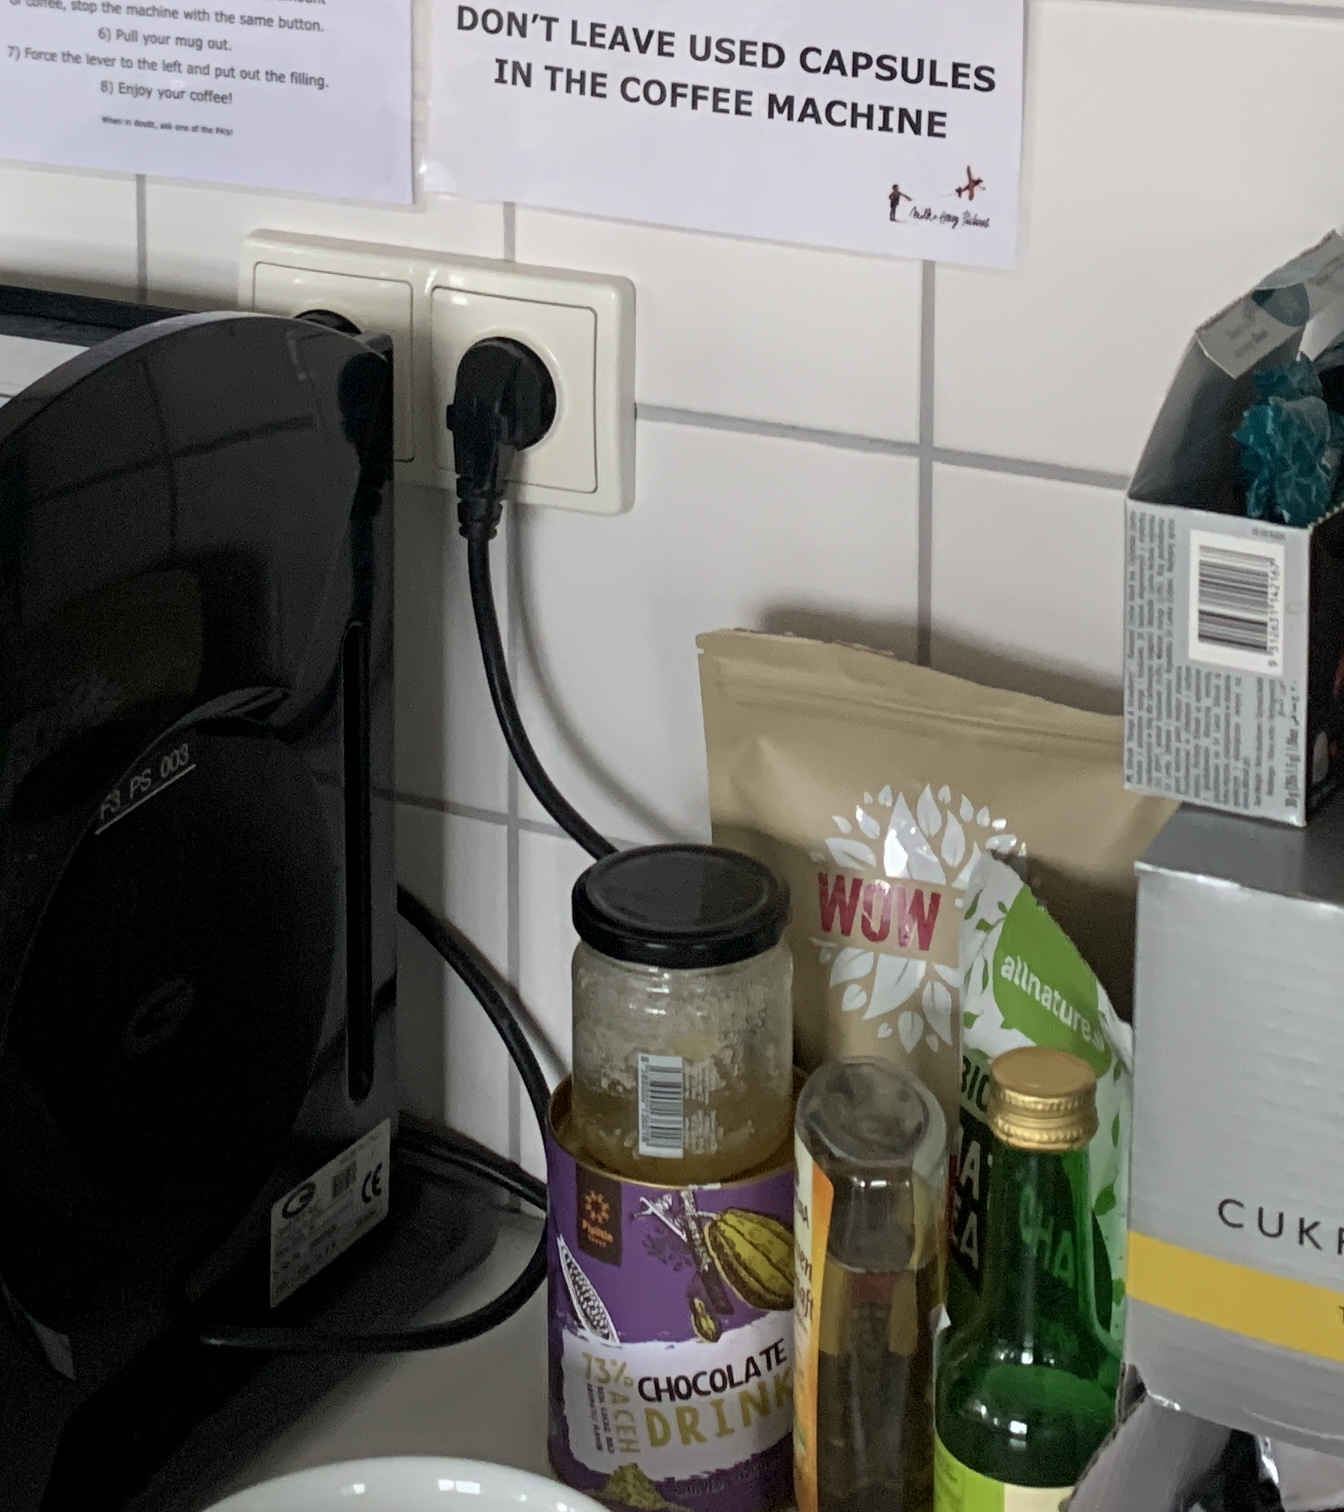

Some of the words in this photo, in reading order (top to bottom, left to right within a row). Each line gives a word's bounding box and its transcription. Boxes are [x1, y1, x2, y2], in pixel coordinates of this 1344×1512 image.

[71, 0, 97, 15] stop
[101, 1, 123, 15] the
[126, 5, 180, 19] machine
[183, 8, 211, 23] with
[214, 11, 236, 24] the
[239, 14, 275, 28] same
[278, 16, 325, 33] button.
[98, 27, 112, 43] 6)
[116, 29, 139, 43] Pull
[143, 33, 172, 47] your
[175, 37, 204, 52] mug
[207, 38, 233, 52] out.
[7, 45, 22, 62] 7)
[24, 47, 58, 62] Force
[61, 51, 82, 65] the
[85, 53, 117, 67] lever
[120, 56, 134, 70] to
[137, 58, 158, 72] the
[162, 59, 183, 74] left
[186, 63, 211, 76] and
[215, 65, 237, 81] put
[239, 68, 262, 82] out
[265, 69, 287, 84] the
[290, 71, 330, 91] filling.
[457, 5, 559, 42] DON'T
[571, 19, 676, 58] LEAVE
[690, 34, 786, 69] USED
[799, 46, 997, 93] CAPSULES
[100, 80, 115, 96] 8)
[118, 81, 154, 100] Enjoy
[157, 88, 186, 102] your
[189, 90, 233, 105] coffee!
[494, 58, 532, 88] IN
[544, 65, 608, 100] THE
[620, 76, 754, 117] COFFEE
[768, 93, 948, 140] MACHINE
[817, 871, 942, 952] WOW
[581, 1351, 634, 1388] 73%
[637, 1338, 788, 1403] CHOCOLATE
[608, 1389, 641, 1454] ACEH
